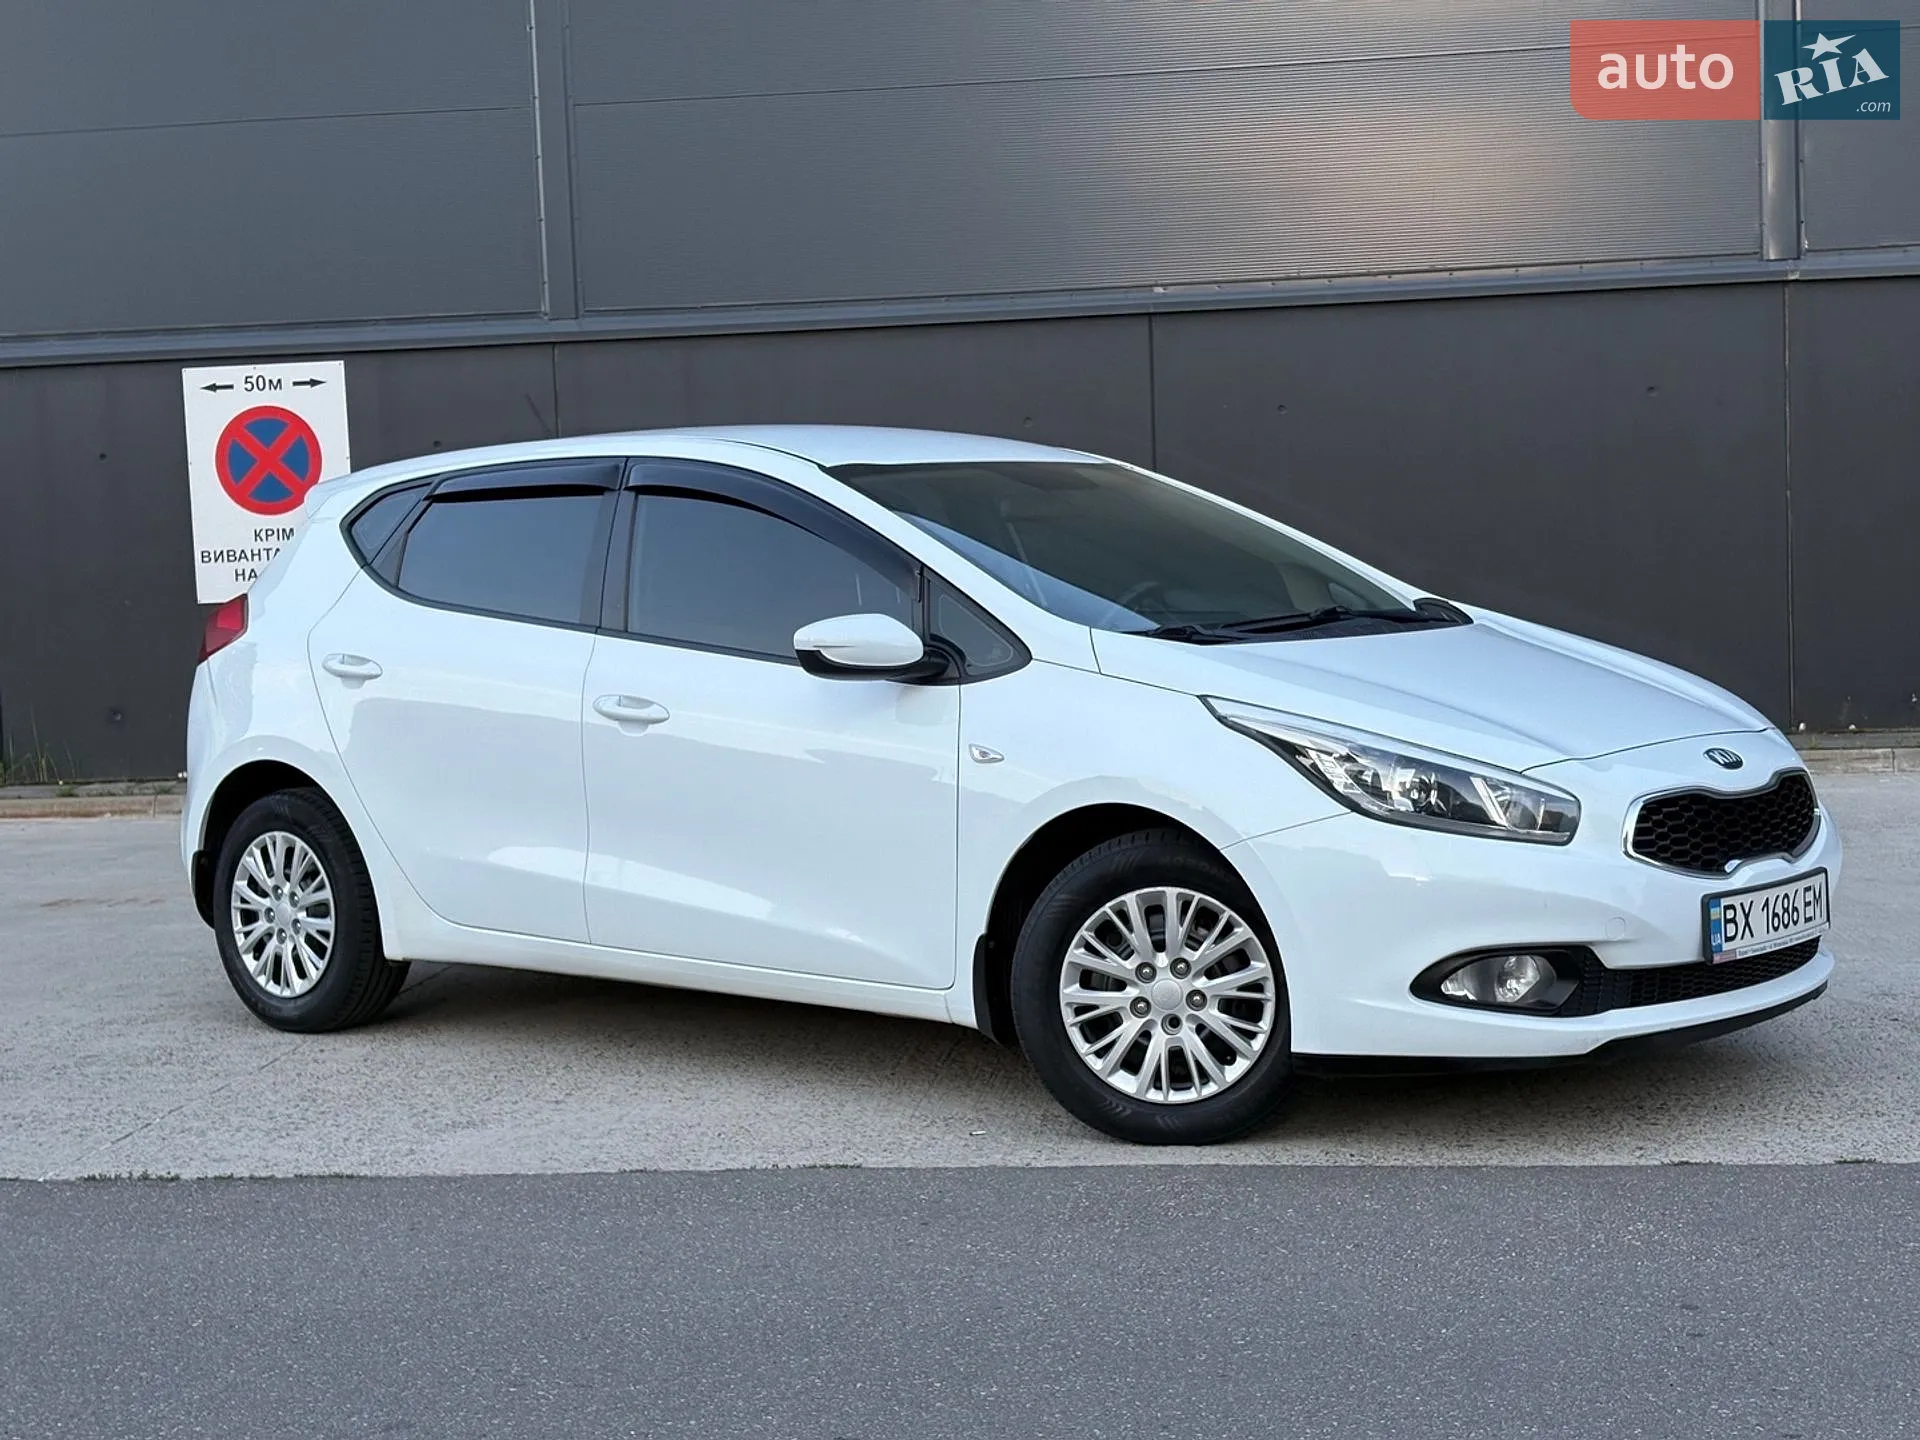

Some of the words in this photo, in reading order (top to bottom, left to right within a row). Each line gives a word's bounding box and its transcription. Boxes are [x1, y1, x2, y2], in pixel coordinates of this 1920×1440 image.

[254, 527, 294, 542] КРІМ
[1723, 900, 1754, 943] BX
[1761, 888, 1800, 934] 1686
[1803, 882, 1823, 924] EM
